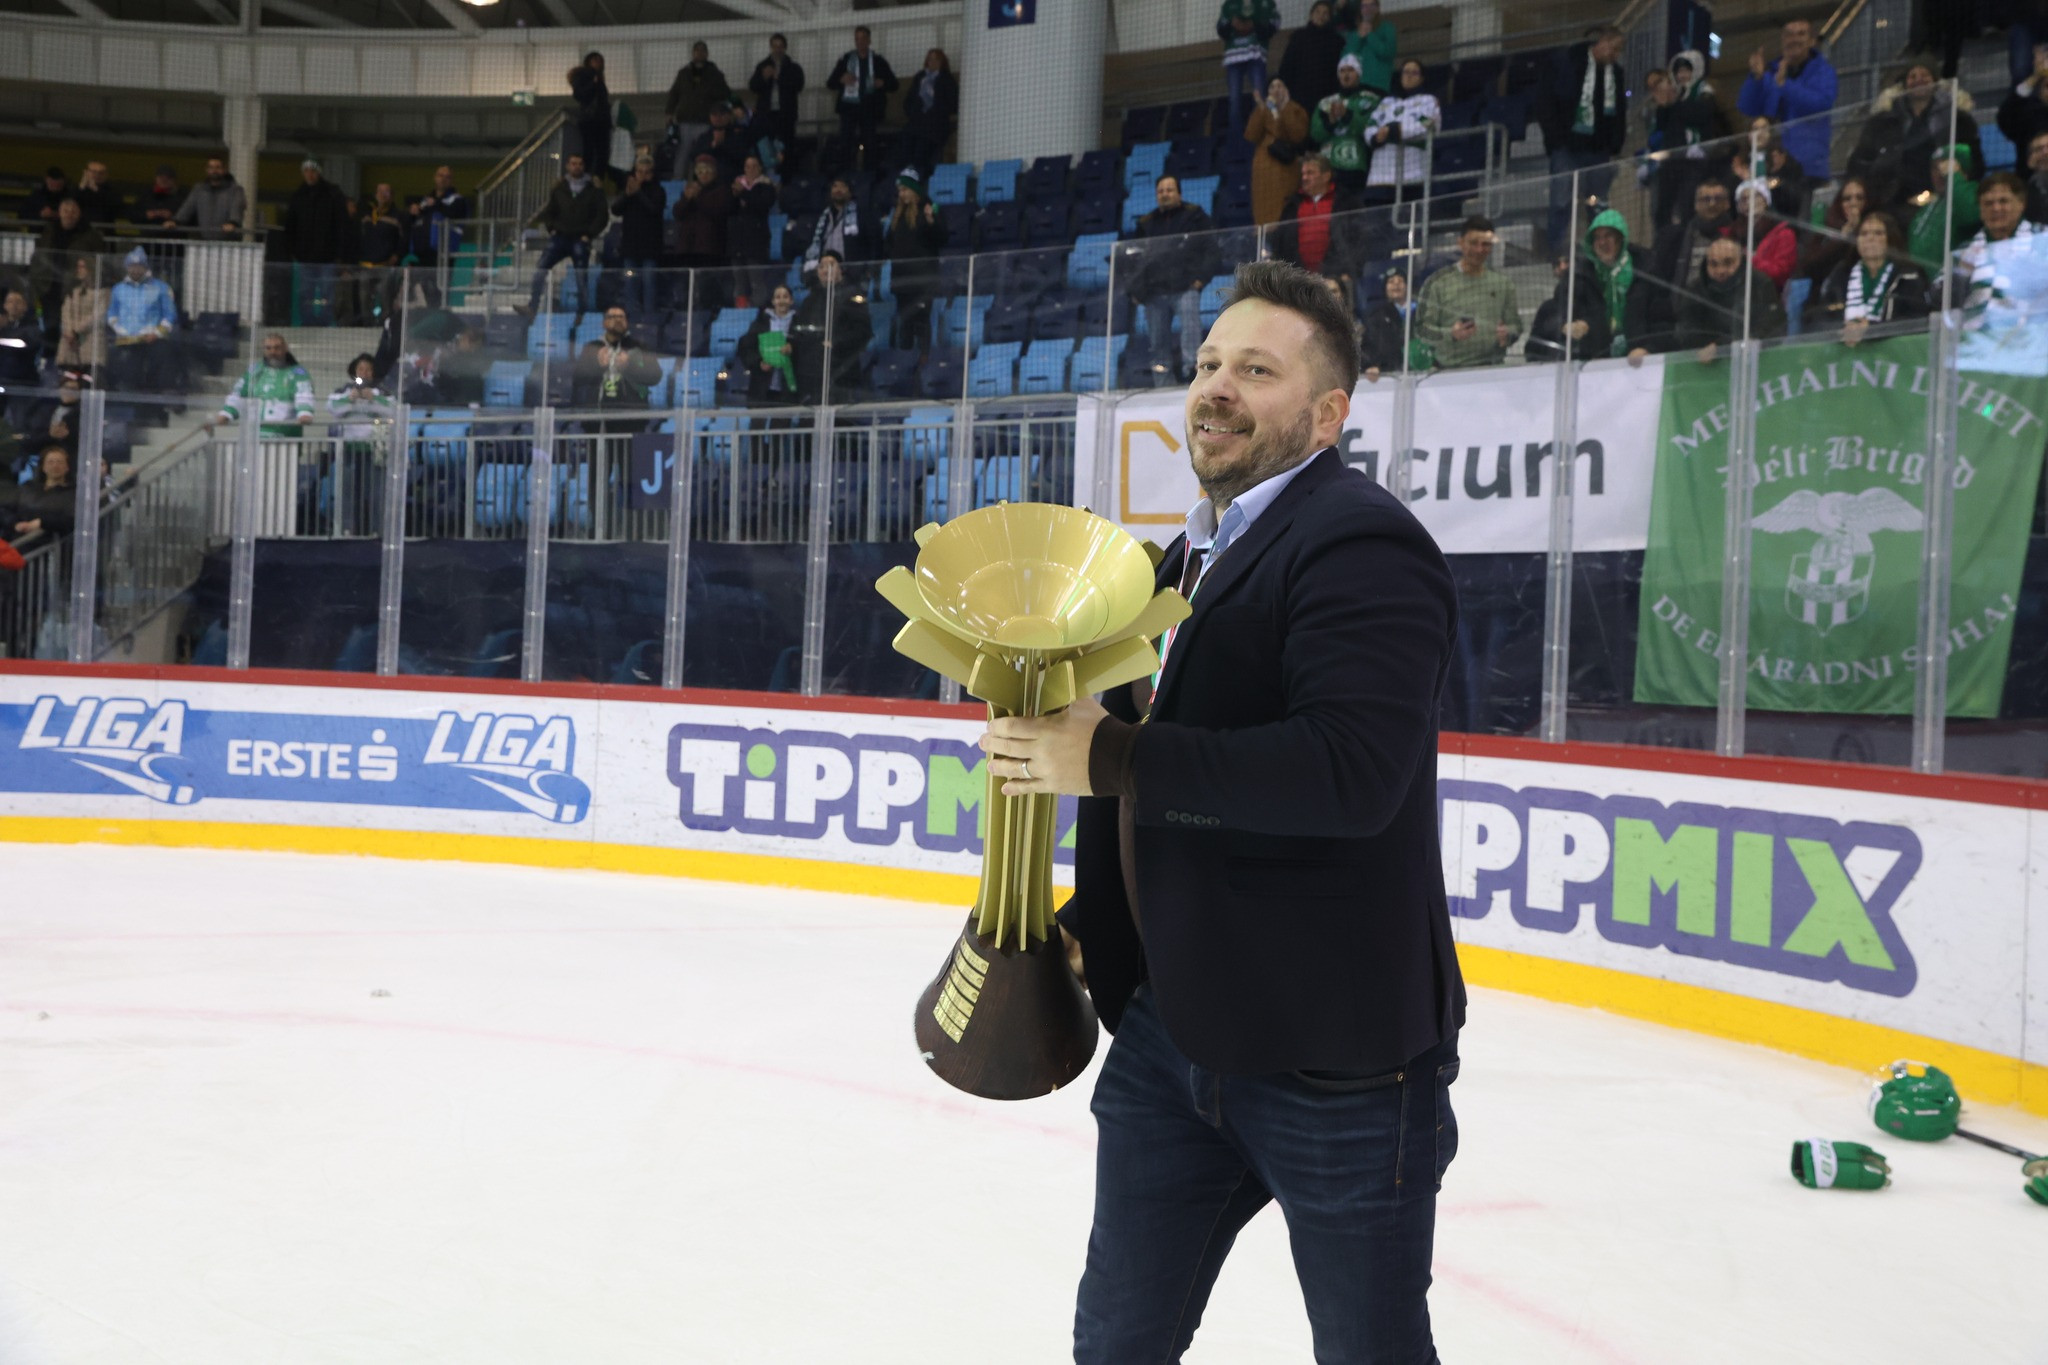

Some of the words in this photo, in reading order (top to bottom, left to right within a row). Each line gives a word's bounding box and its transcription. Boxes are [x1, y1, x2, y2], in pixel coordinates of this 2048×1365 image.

[1671, 359, 1900, 458] MEHALNI
[1909, 366, 2045, 438] LHET
[1338, 428, 1604, 501] ficium
[1824, 436, 1977, 490] Brigd
[1651, 594, 1696, 639] DE
[1695, 628, 1894, 684] EÁRADNI
[1901, 593, 2017, 672] SHA!
[18, 697, 188, 754] LIGA
[227, 739, 352, 780] ERSTE
[423, 713, 570, 768] LIGA
[680, 738, 1076, 848] TiPPM
[1441, 798, 1902, 971] PPMIX
